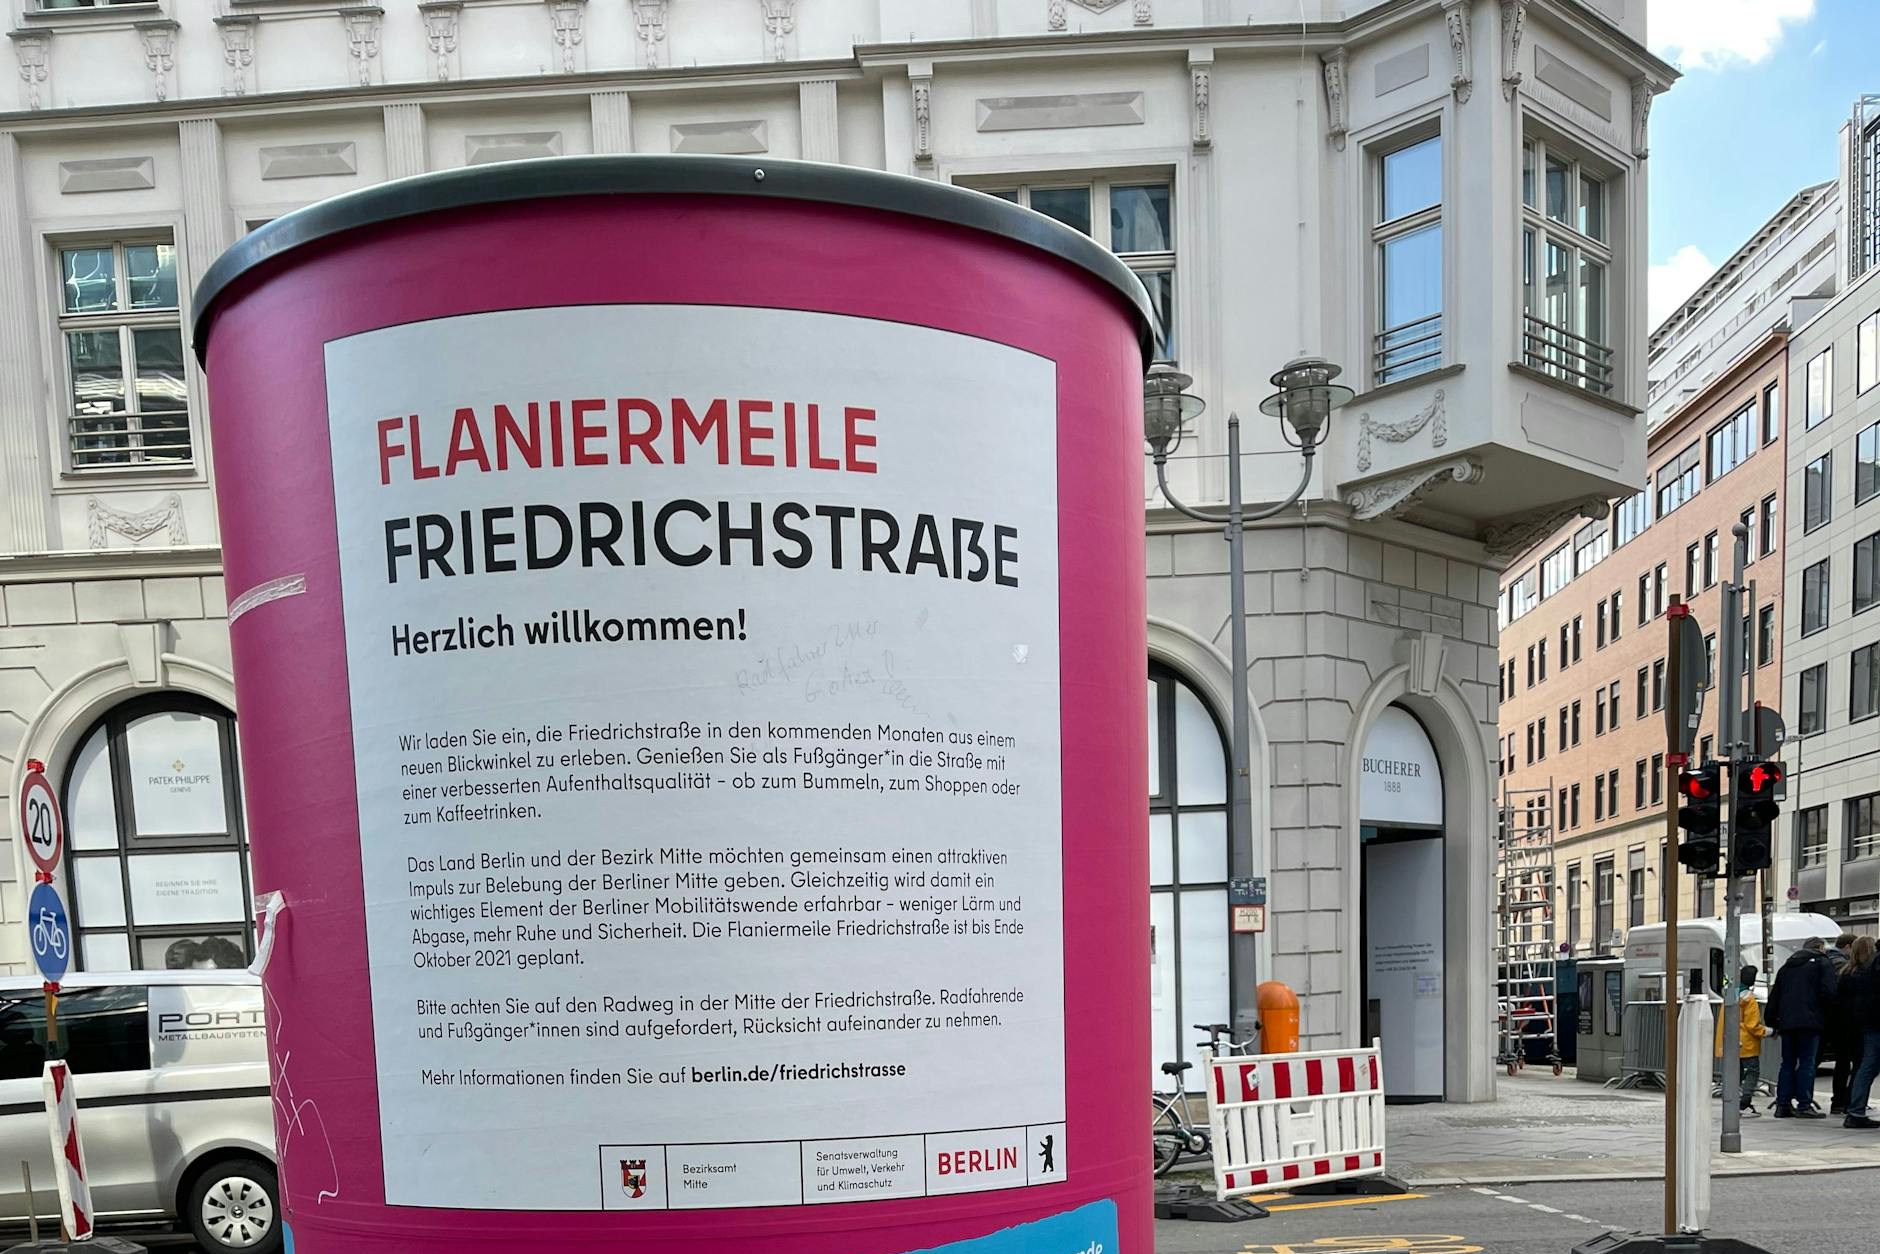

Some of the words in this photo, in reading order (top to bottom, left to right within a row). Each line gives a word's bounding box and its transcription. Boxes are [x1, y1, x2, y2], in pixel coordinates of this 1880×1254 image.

[378, 398, 877, 485] FLANIERMEILE
[385, 499, 1018, 588] FRIEDRICHSTRAßE
[392, 614, 514, 656] Herzlich
[524, 608, 746, 645] willkommen!
[398, 734, 422, 751] Wir
[425, 731, 467, 749] laden
[472, 729, 497, 746] Sie
[502, 727, 531, 747] ein,
[536, 725, 562, 743] die
[569, 721, 701, 741] Friedrichstraße
[707, 722, 722, 738] in
[728, 721, 761, 739] den
[768, 721, 871, 740] kommenden
[878, 724, 944, 743] Monaten
[948, 732, 973, 745] aus
[977, 730, 1015, 748] einem
[401, 761, 443, 776] neuen
[448, 751, 532, 772] Blickwinkel
[536, 755, 554, 768] zu
[560, 748, 631, 767] erleben.
[636, 746, 724, 765] Genießen
[730, 746, 757, 764] Sie
[762, 746, 787, 764] als
[909, 749, 932, 767] die
[937, 751, 982, 769] Straße
[987, 755, 1005, 771] mit
[1362, 758, 1421, 777] BUCHERER
[149, 776, 174, 785] PATEK
[175, 775, 211, 784] PHILIPPE
[402, 784, 437, 800] einer
[440, 777, 541, 798] verbesserten
[546, 772, 711, 794] Aufenthaltsqualität
[732, 771, 756, 789] ob
[761, 777, 796, 789] zum
[803, 772, 884, 794] Bummeln,
[889, 779, 920, 791] zum
[925, 774, 987, 796] Shoppen
[991, 778, 1020, 795] oder
[1384, 781, 1401, 792] 1888
[29, 798, 52, 847] 20
[404, 812, 431, 825] zum
[436, 802, 541, 823] Kaffeetrinken.
[407, 856, 435, 873] Das
[439, 853, 475, 871] Land
[481, 851, 525, 869] Berlin
[531, 850, 561, 868] und
[567, 849, 596, 866] der
[601, 847, 654, 865] Bezirk
[660, 848, 702, 864] Mitte
[709, 846, 784, 864] möchten
[790, 847, 886, 868] gemeinsam
[892, 847, 932, 864] einen
[937, 848, 1007, 865] attraktiven
[181, 888, 218, 896] TRADITION
[409, 878, 454, 900] Impuls
[458, 882, 481, 895] zur
[486, 875, 562, 896] Belebung
[568, 874, 597, 891] der
[603, 873, 670, 890] Berliner
[676, 872, 718, 889] Mitte
[724, 871, 785, 893] geben.
[790, 870, 889, 891] Gleichzeitig
[894, 870, 925, 887] wird
[930, 871, 971, 887] damit
[975, 872, 994, 888] ein
[410, 903, 475, 923] wichtiges
[480, 900, 543, 918] Element
[549, 899, 577, 916] der
[583, 898, 649, 915] Berliner
[655, 895, 798, 914] Mobilitätswende
[804, 895, 882, 912] erfahrbar
[899, 895, 958, 915] weniger
[962, 895, 995, 911] Lärm
[999, 896, 1021, 911] und
[412, 928, 469, 948] Abgase,
[473, 925, 512, 943] mehr
[516, 924, 556, 941] Ruhe
[562, 923, 592, 940] und
[598, 922, 687, 940] Sicherheit.
[693, 921, 722, 938] Die
[728, 920, 831, 937] Flaniermeile
[837, 918, 949, 936] Friedrichstraße
[954, 919, 968, 935] ist
[972, 918, 990, 935] bis
[994, 918, 1024, 934] Ende
[413, 951, 471, 968] Oktober
[475, 949, 511, 967] 2021
[517, 948, 584, 970] geplant.
[417, 999, 446, 1015] Bitte
[451, 998, 500, 1015] achten
[505, 997, 530, 1014] Sie
[535, 996, 561, 1014] auf
[566, 996, 597, 1013] den
[603, 995, 673, 1016] Radweg
[680, 995, 694, 1011] in
[700, 994, 729, 1011] der
[735, 994, 776, 1010] Mitte
[781, 992, 810, 1009] der
[815, 989, 935, 1008] Friedrichstraße.
[940, 987, 1024, 1005] Radfahrende
[418, 1022, 443, 1039] und
[586, 1020, 619, 1037] sind
[625, 1018, 737, 1040] aufgefordert,
[743, 1016, 821, 1034] Rücksicht
[827, 1013, 922, 1032] aufeinander
[925, 1017, 941, 1029] zu
[946, 1011, 1002, 1027] nehmen.
[422, 1069, 455, 1085] Mehr
[459, 1068, 564, 1085] Informationen
[570, 1068, 621, 1085] finden
[627, 1067, 653, 1084] Sie
[658, 1066, 686, 1084] auf
[691, 1062, 906, 1083] berlin.de/friedrichstrasse
[682, 1163, 737, 1174] Bezirksamt
[816, 1149, 898, 1161] Senatsverwaltung
[938, 1146, 1017, 1175] BERLIN
[817, 1166, 829, 1176] für
[832, 1164, 869, 1176] Umwelt,
[871, 1162, 905, 1173] Verkehr
[683, 1179, 708, 1189] Mitte
[817, 1181, 835, 1192] und
[838, 1179, 892, 1190] Klimaschutz
